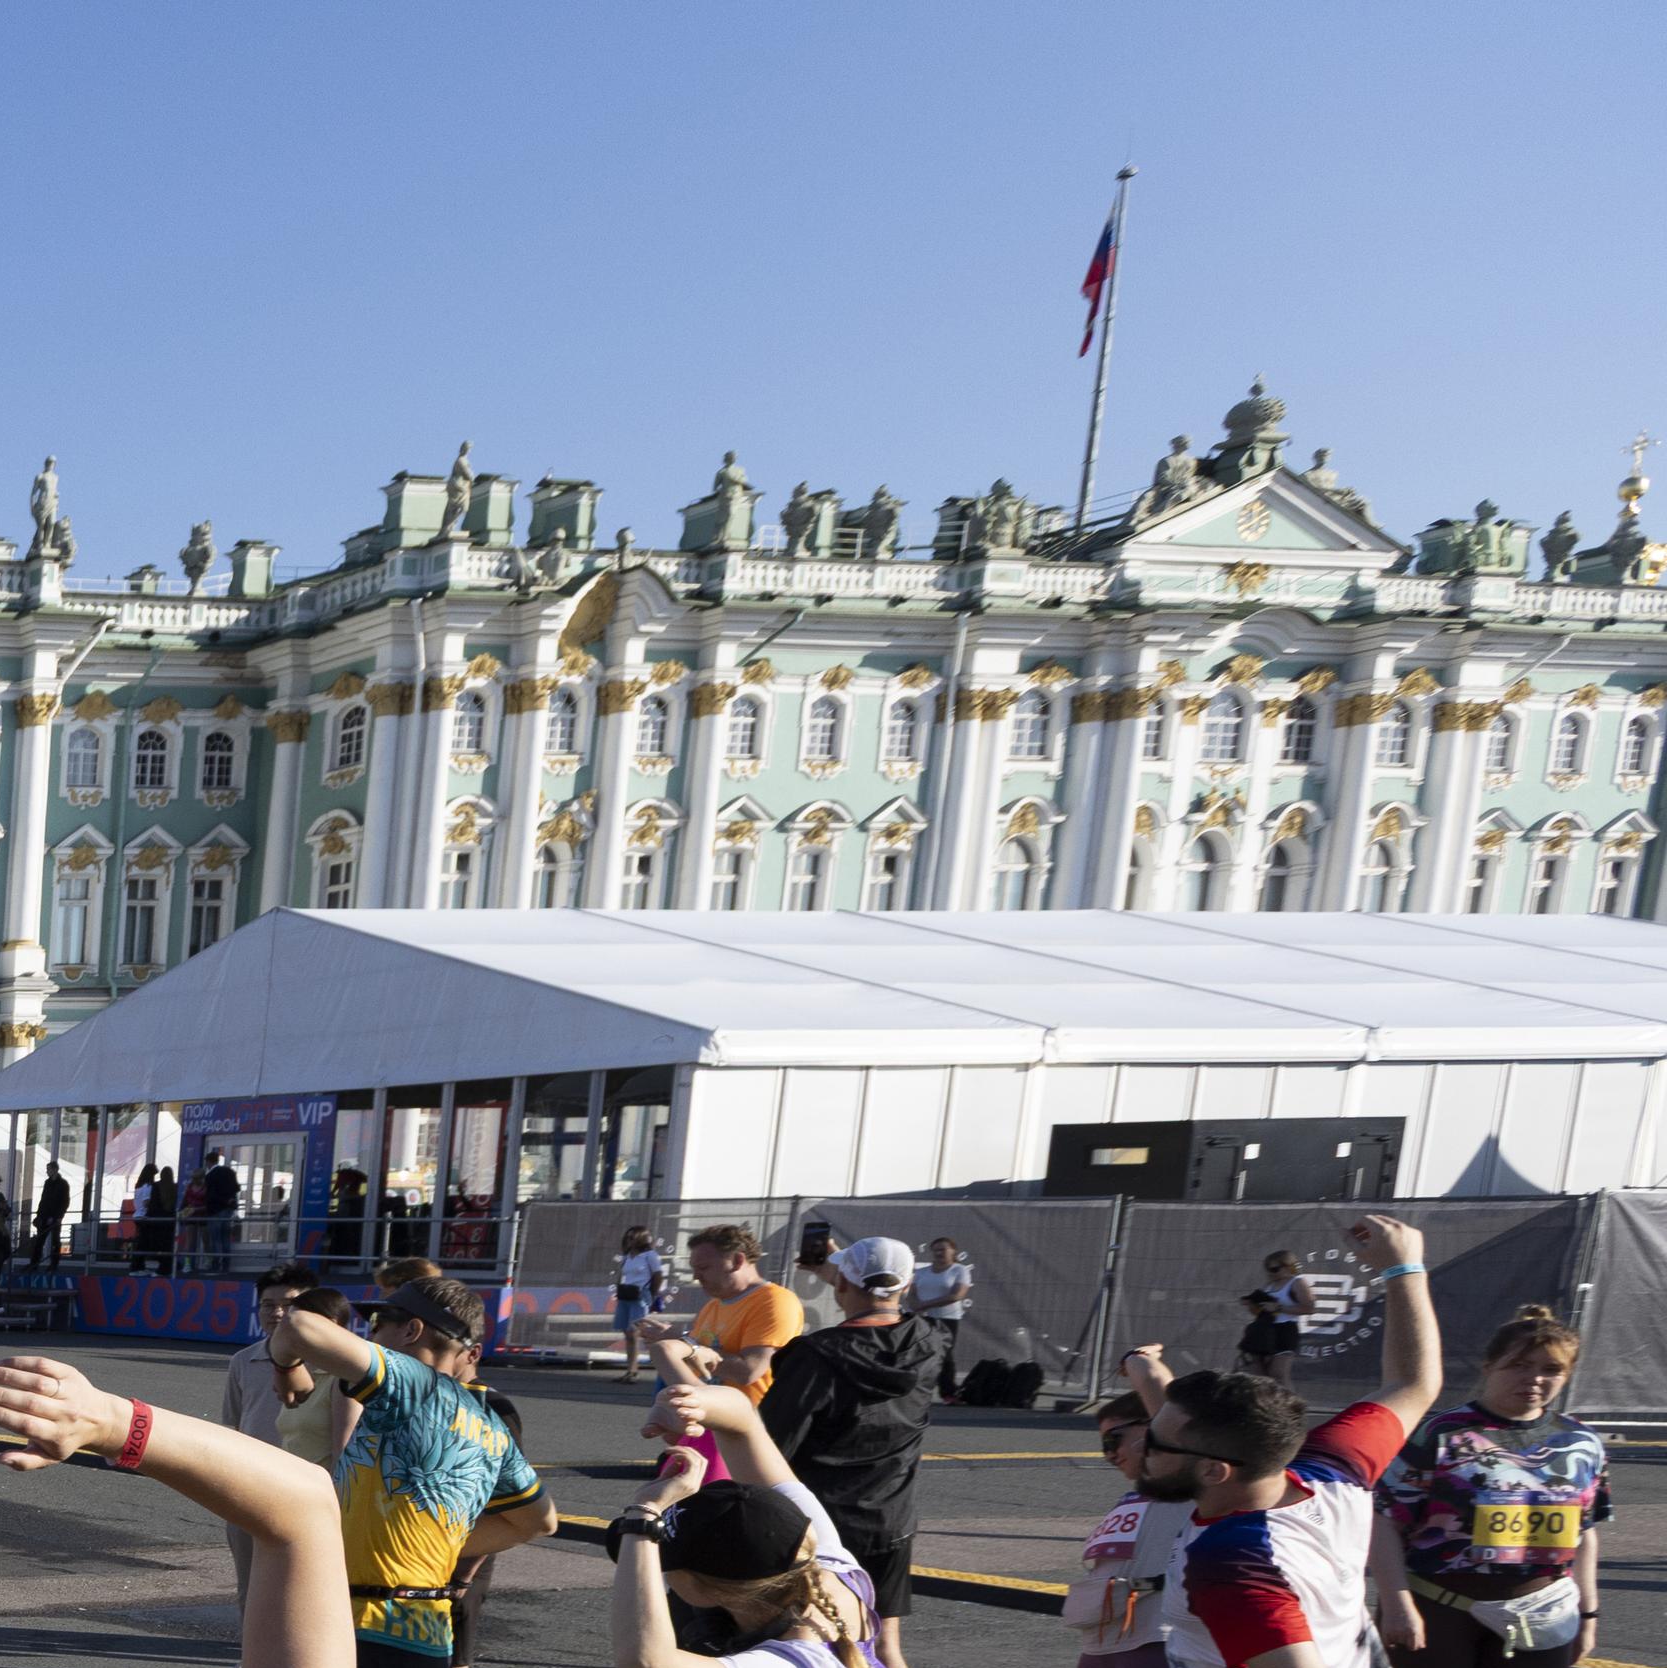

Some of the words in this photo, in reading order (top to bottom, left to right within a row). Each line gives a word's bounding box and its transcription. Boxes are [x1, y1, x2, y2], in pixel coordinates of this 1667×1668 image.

[298, 1101, 334, 1125] VIP
[113, 1276, 242, 1336] 2025
[125, 1414, 148, 1457] 10074
[1488, 1511, 1565, 1535] 8690
